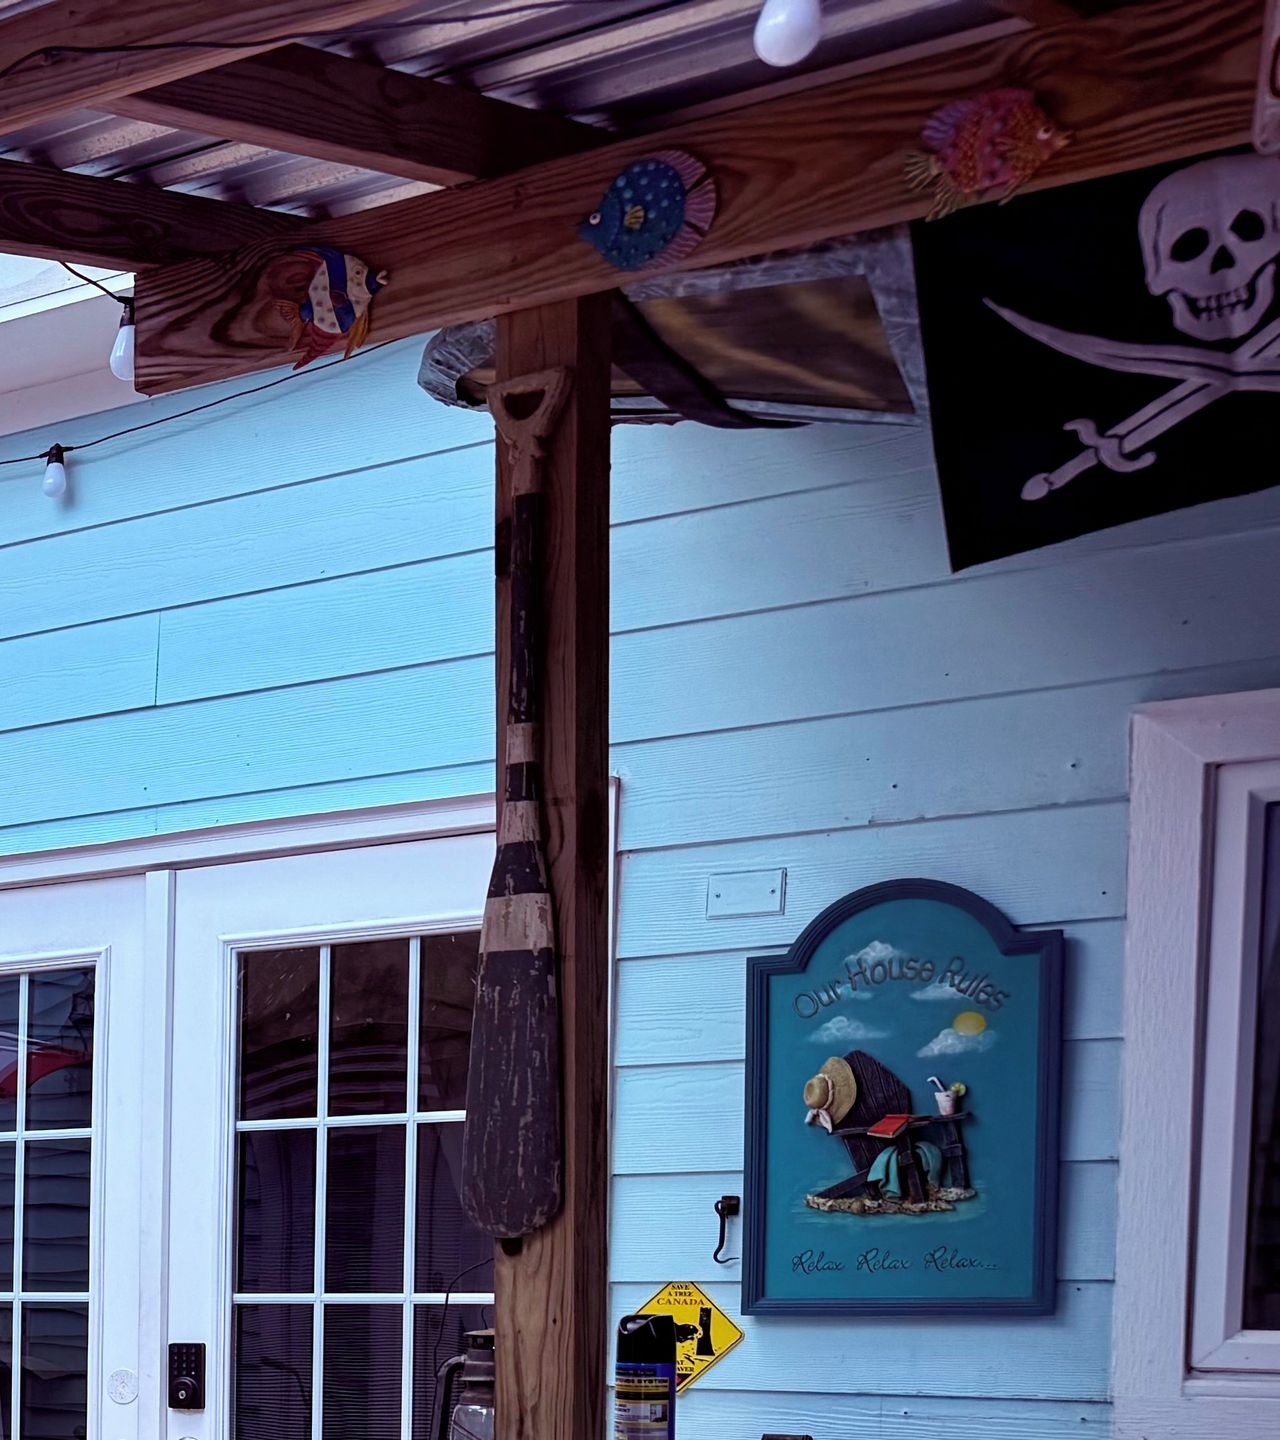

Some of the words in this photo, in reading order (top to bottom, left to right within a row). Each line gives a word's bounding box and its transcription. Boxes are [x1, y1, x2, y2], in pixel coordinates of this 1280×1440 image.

[793, 977, 842, 1018] Our
[844, 956, 935, 991] House
[937, 955, 1011, 1012] Rules
[792, 1250, 846, 1275] Relax
[856, 1247, 911, 1273] Relax
